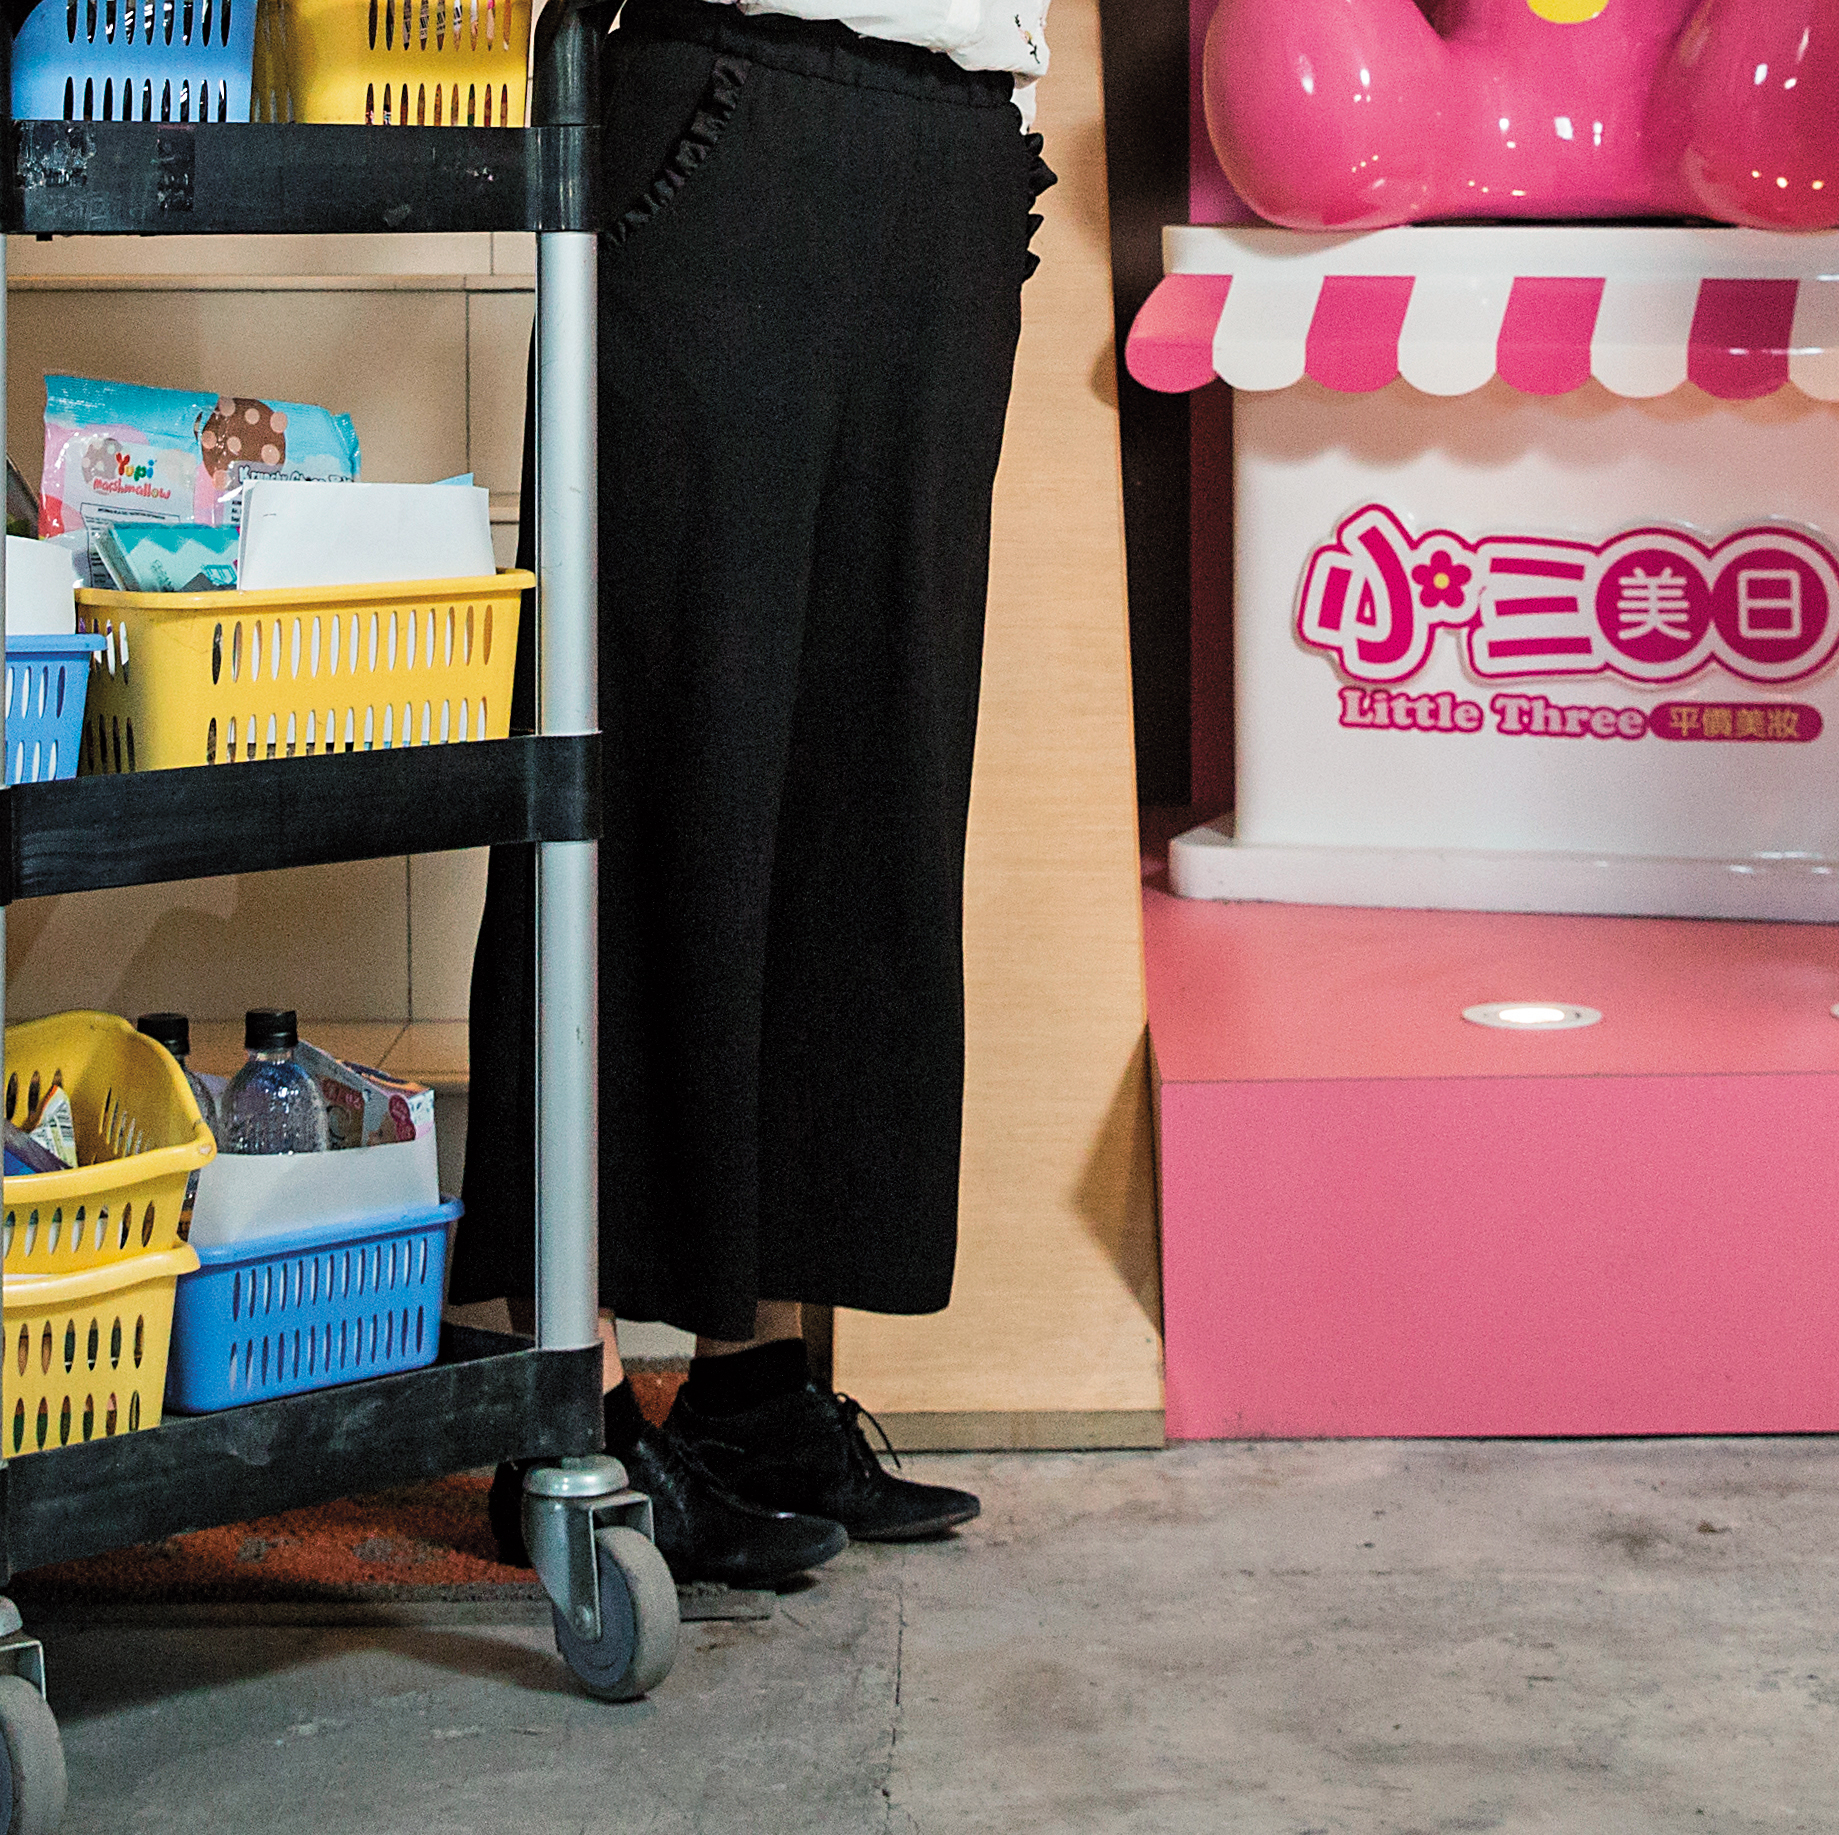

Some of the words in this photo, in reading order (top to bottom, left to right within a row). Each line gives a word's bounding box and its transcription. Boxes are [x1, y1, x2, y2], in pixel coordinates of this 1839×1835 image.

[115, 452, 154, 482] Yupi
[93, 477, 171, 500] Marshmallow
[1317, 525, 1830, 664] 小三美日
[1341, 688, 1483, 734] Little
[1492, 692, 1651, 741] Three
